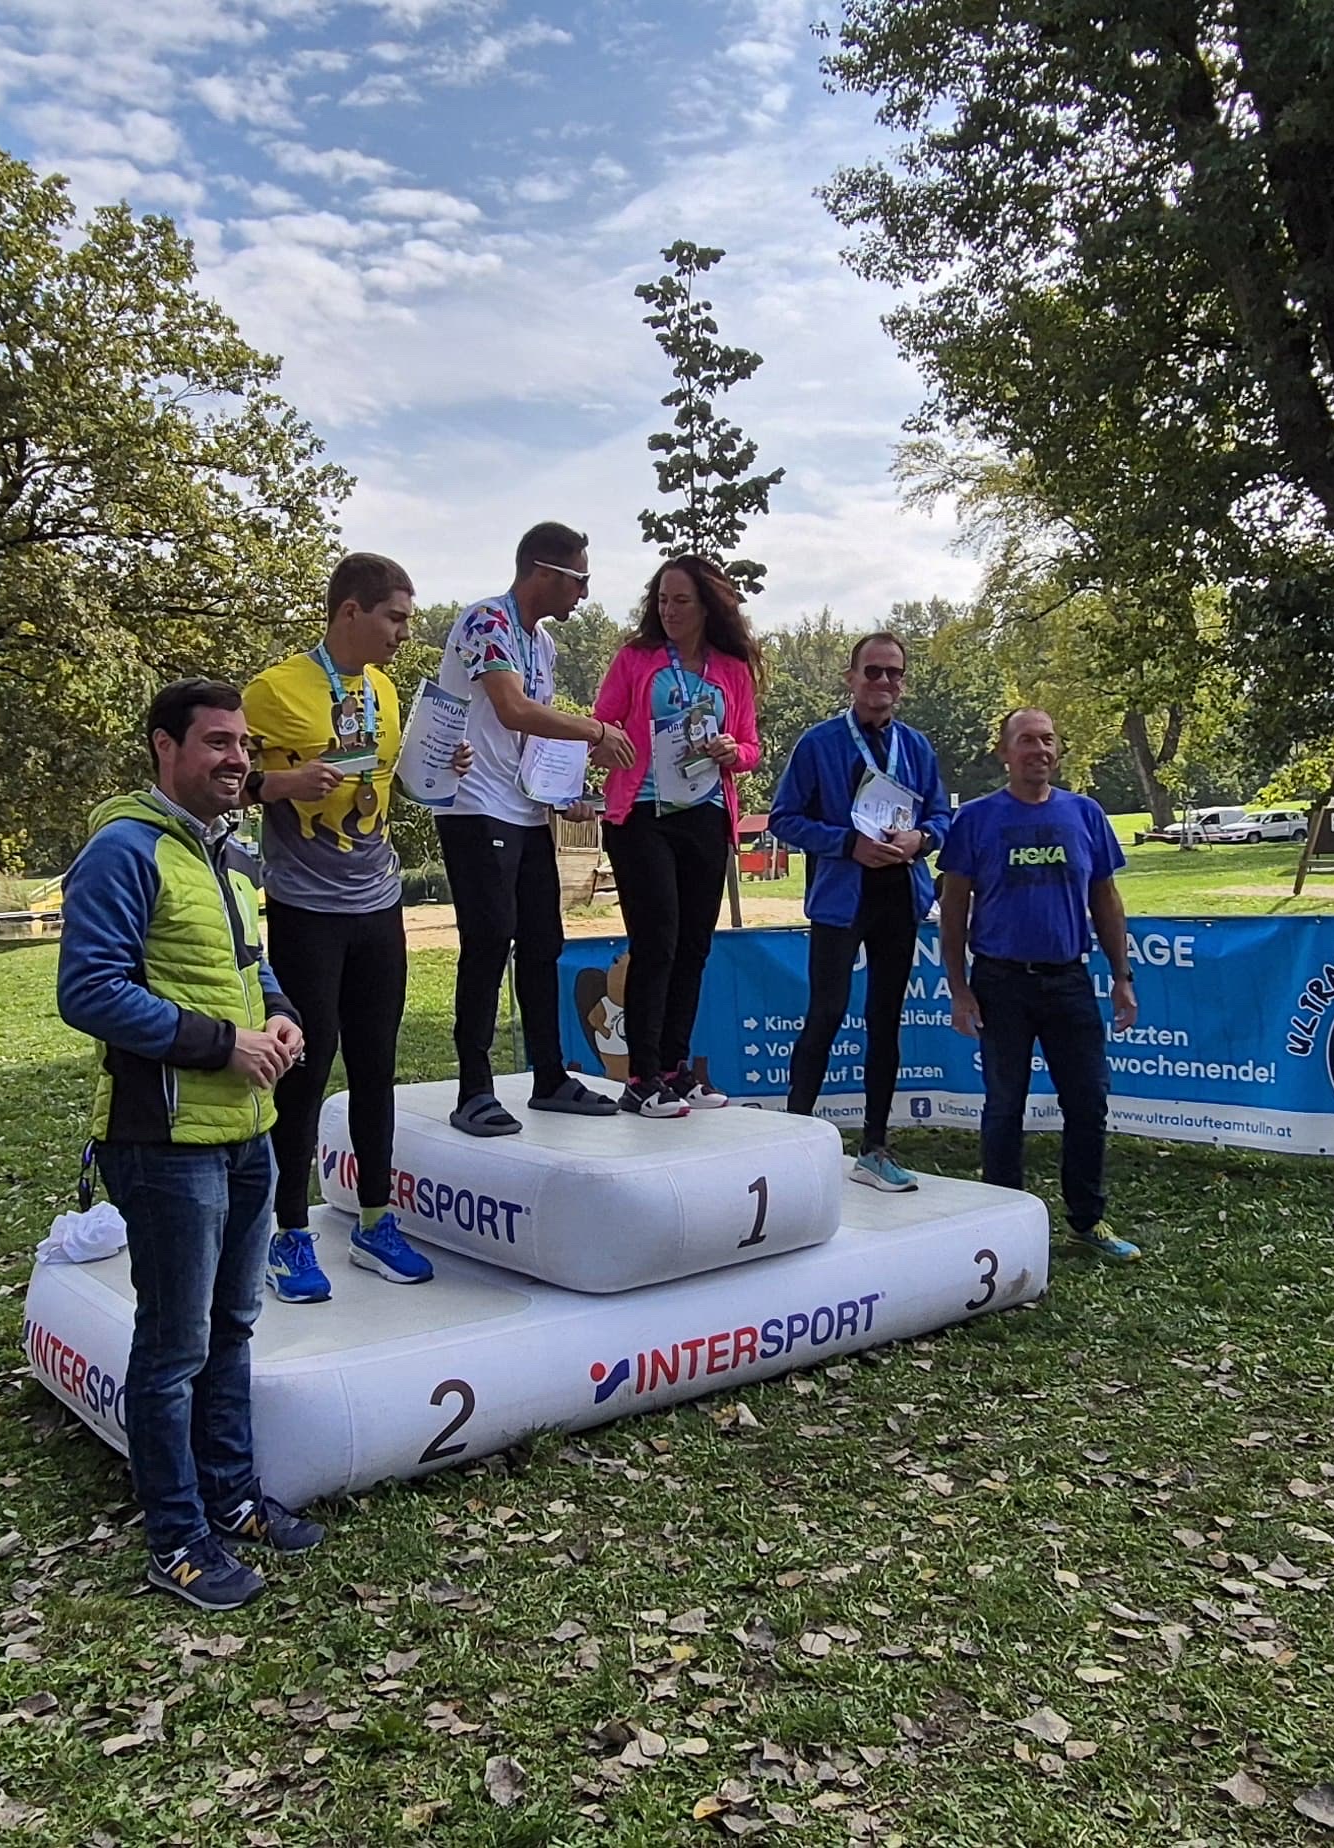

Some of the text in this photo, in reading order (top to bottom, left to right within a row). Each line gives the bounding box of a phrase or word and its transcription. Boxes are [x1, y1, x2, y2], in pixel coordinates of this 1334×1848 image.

[432, 697, 467, 718] URKUN
[1008, 845, 1068, 866] HOKA
[1106, 1022, 1189, 1047] letzten
[1111, 1109, 1292, 1139] www.ultralaufteamtulln.at
[737, 1175, 768, 1249] 1
[965, 1248, 999, 1311] 3
[635, 1292, 881, 1395] INTERSPORT
[30, 1321, 128, 1432] INTERSPO
[418, 1378, 476, 1465] 2
